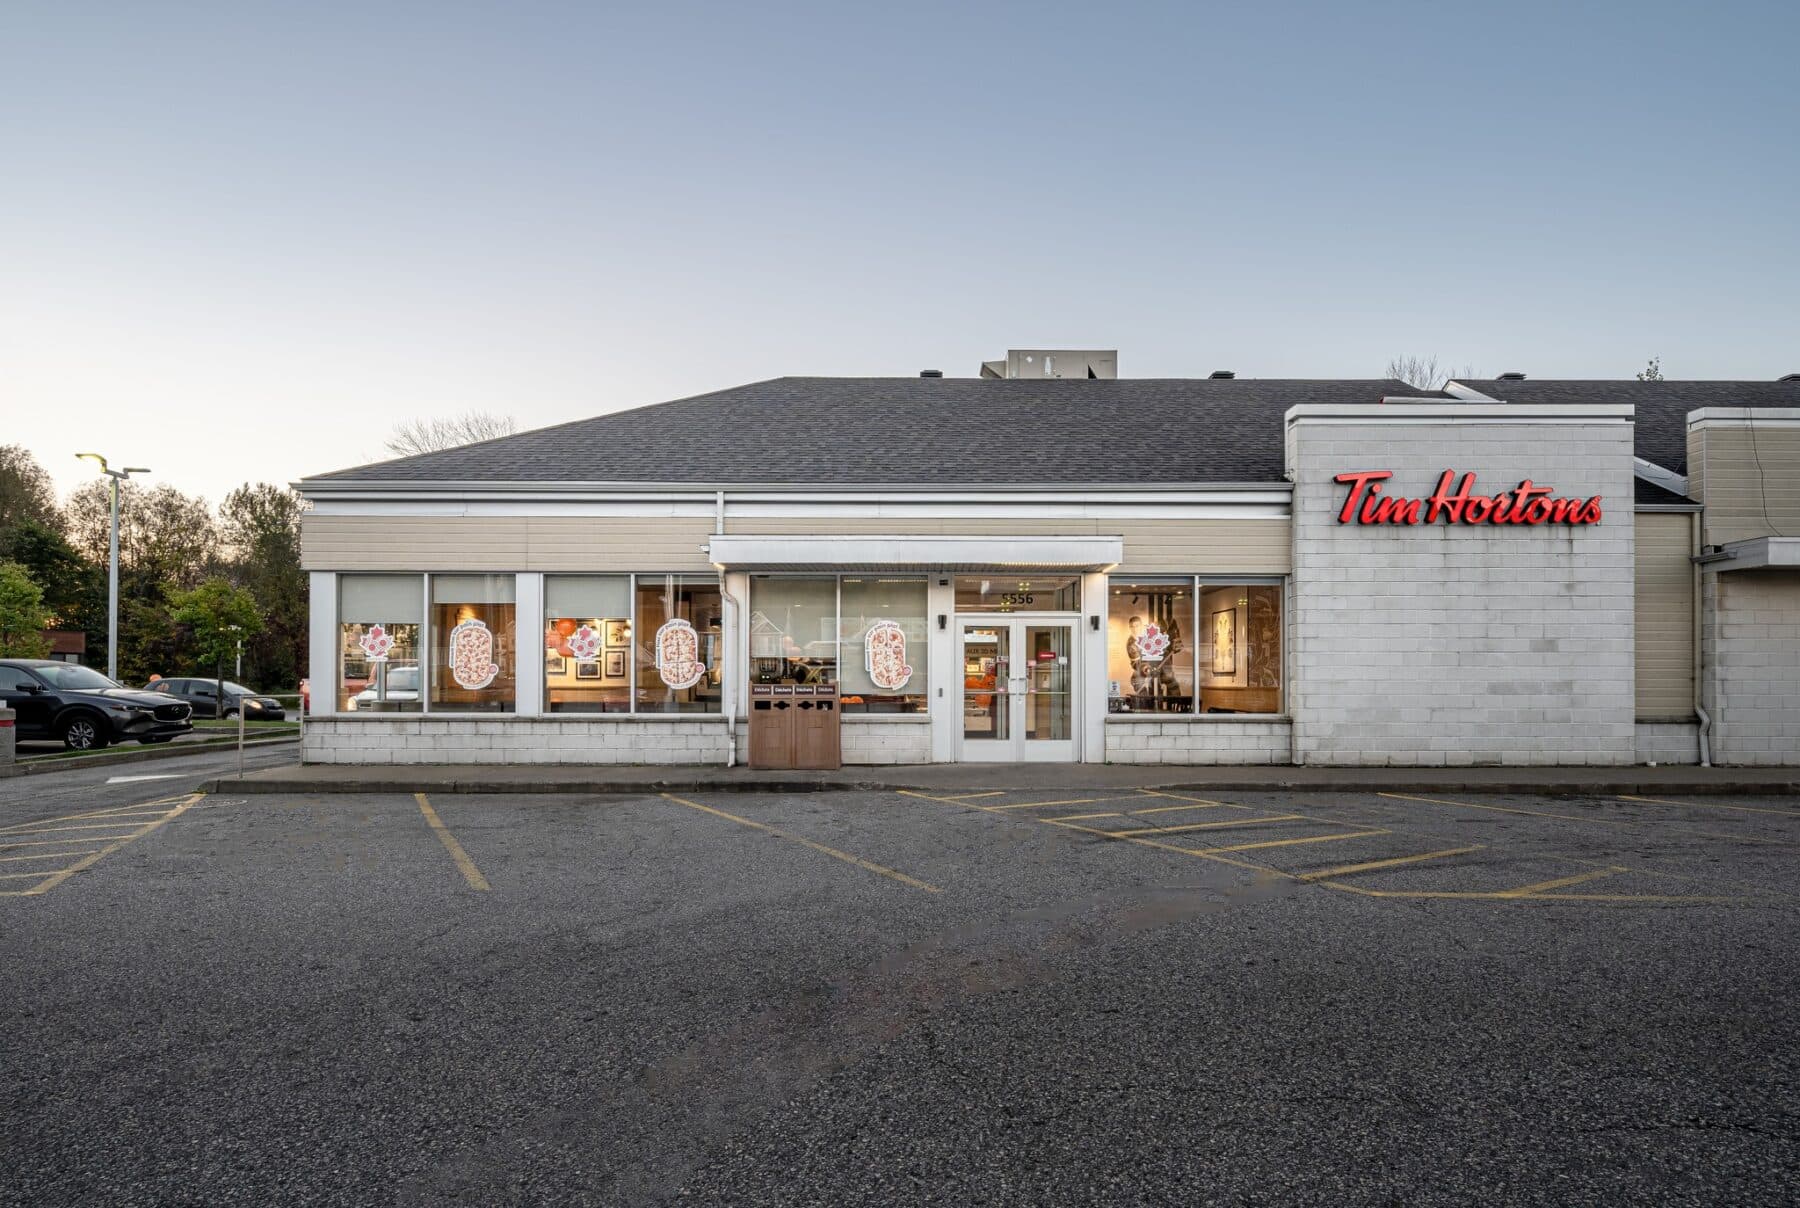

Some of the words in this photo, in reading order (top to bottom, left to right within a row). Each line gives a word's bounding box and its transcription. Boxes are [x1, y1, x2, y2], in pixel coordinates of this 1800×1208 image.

[1333, 470, 1421, 525] Tim
[1425, 468, 1603, 526] Hortons
[1002, 593, 1034, 604] 5556
